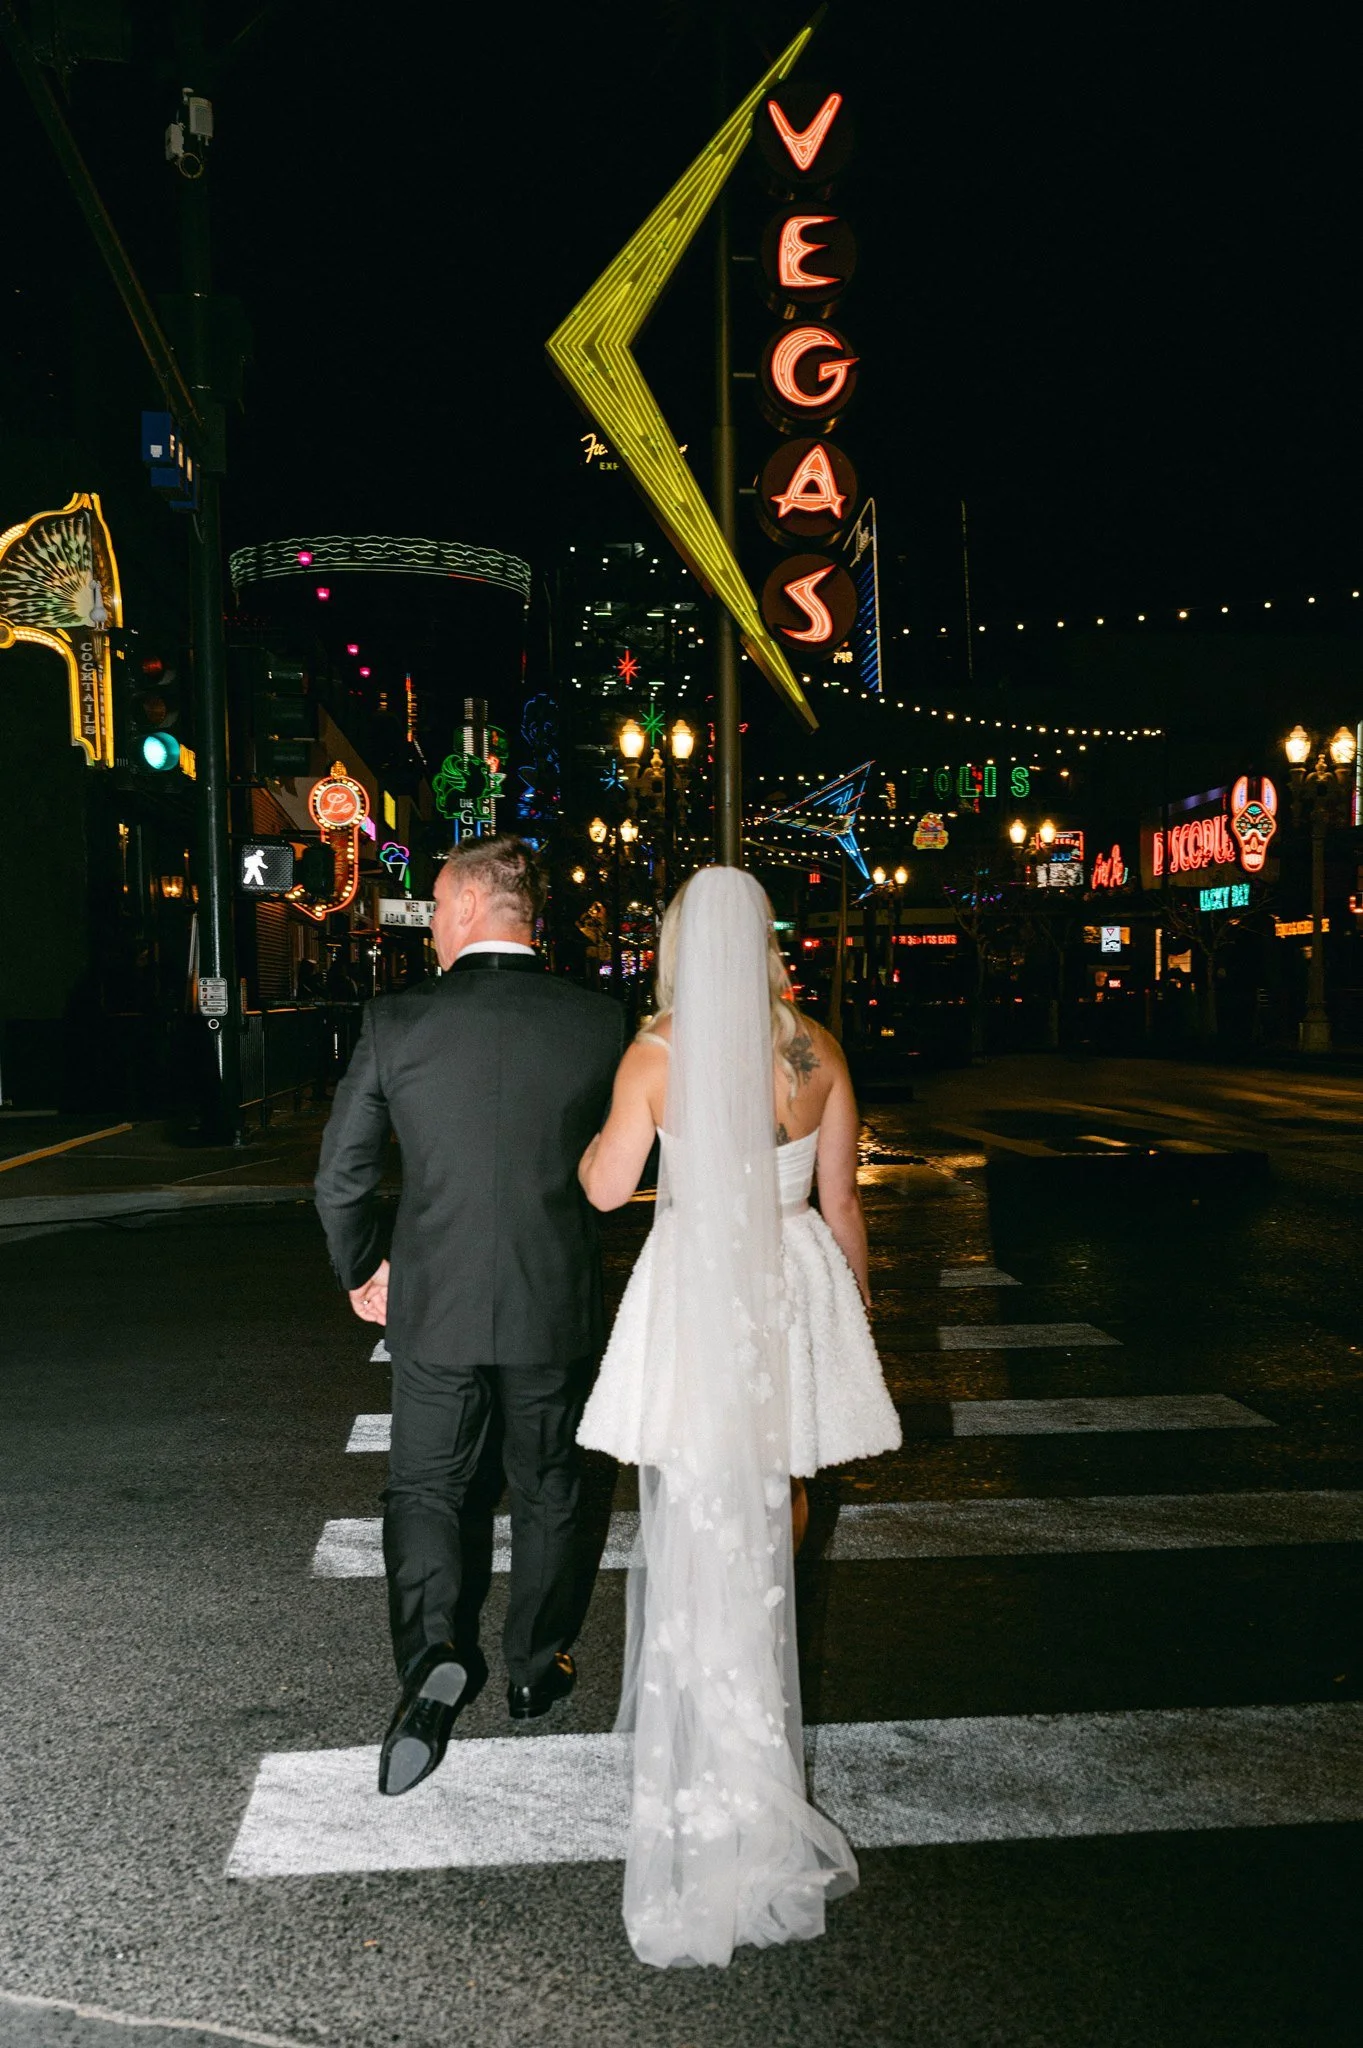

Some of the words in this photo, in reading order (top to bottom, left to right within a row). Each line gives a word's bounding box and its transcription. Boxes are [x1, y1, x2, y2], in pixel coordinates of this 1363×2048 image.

[768, 93, 860, 642] VEGAS
[81, 642, 97, 735] COCKTAILS
[410, 914, 424, 925] THE
[1200, 886, 1230, 912] LUCKY
[1231, 884, 1250, 907] DAY
